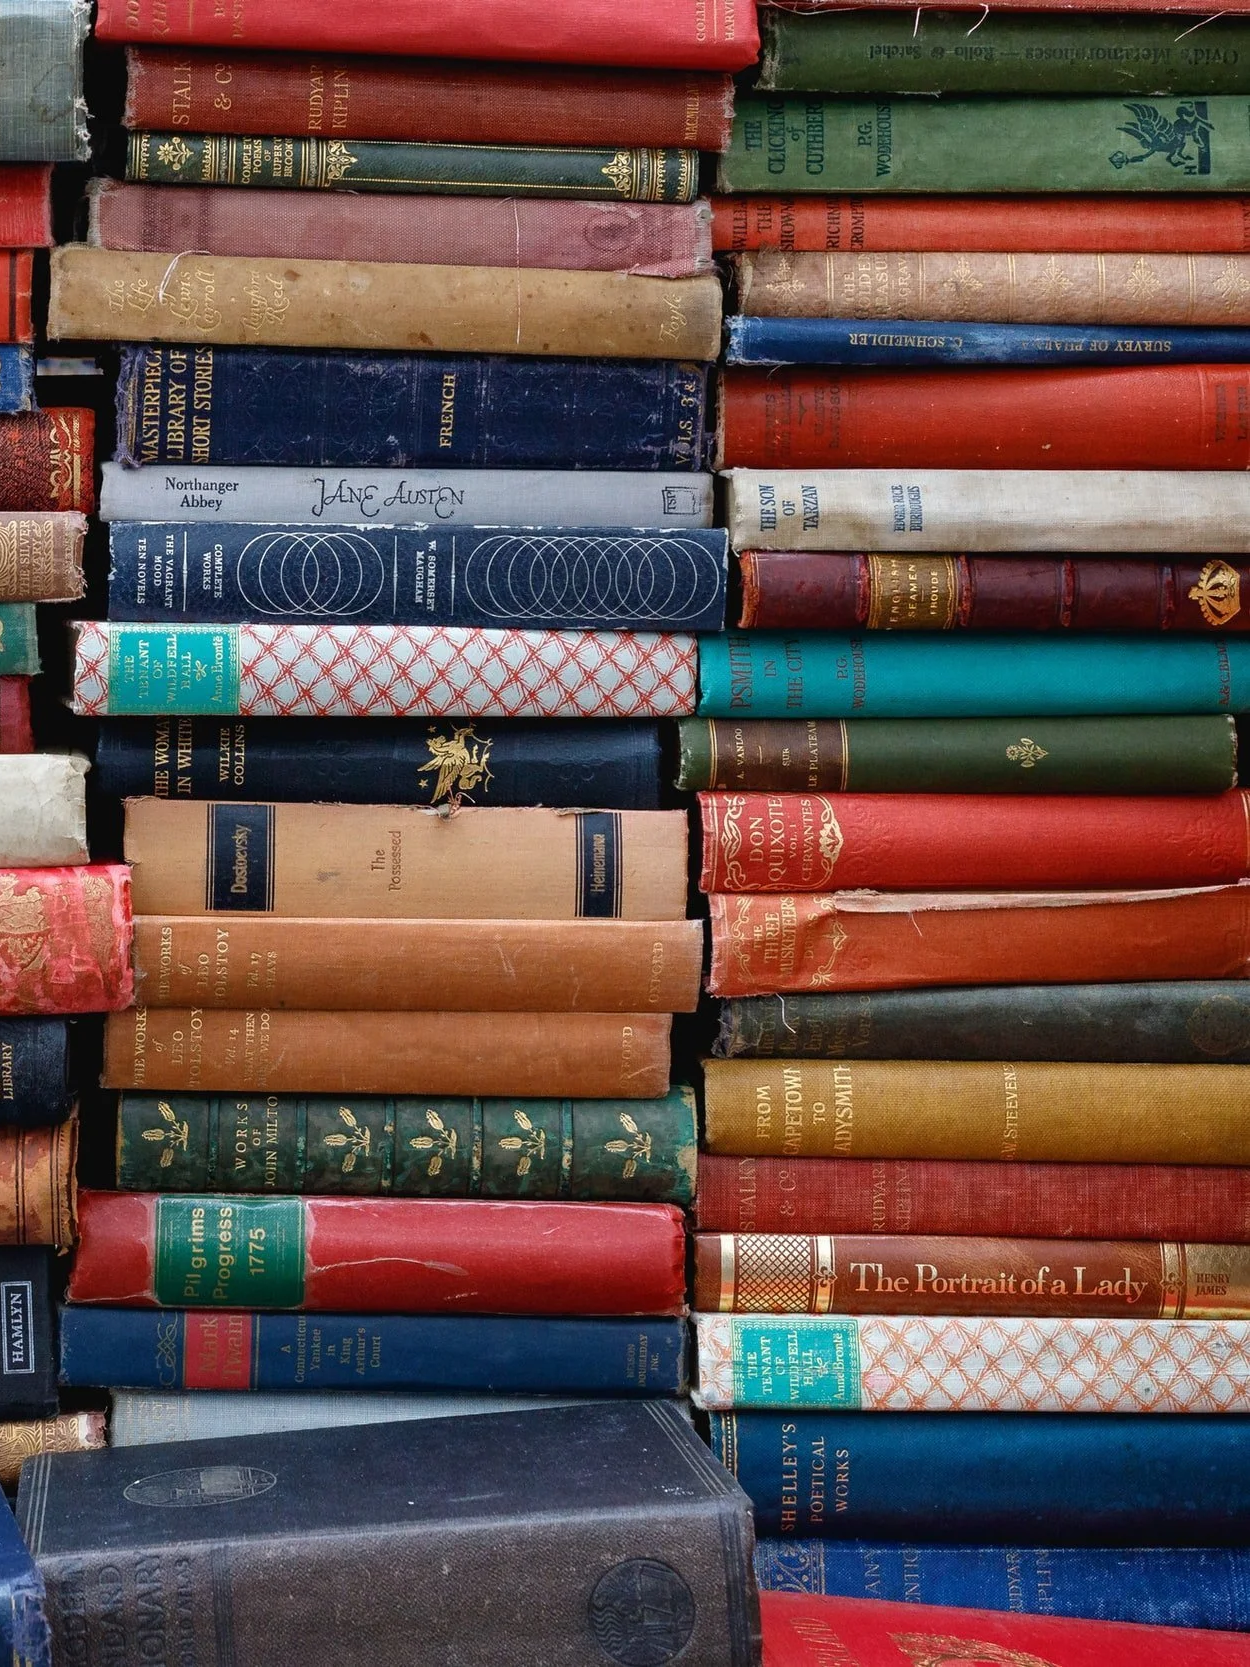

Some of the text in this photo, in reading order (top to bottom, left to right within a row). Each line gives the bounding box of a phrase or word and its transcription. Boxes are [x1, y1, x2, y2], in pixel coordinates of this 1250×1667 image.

[745, 120, 762, 152] THE
[767, 100, 784, 176] CLICKING
[1114, 340, 1172, 353] SURVEY
[167, 349, 187, 461] LIBRARY OF
[192, 346, 213, 463] SHORT STORIES
[439, 373, 456, 448] FRENCH
[165, 478, 239, 494] Northanger
[180, 495, 223, 512] Abbey
[312, 478, 465, 519] JANE AUSTEN
[760, 485, 775, 532] THE SON
[802, 485, 818, 531] TARZAN
[137, 559, 147, 605] NOVELS
[154, 555, 163, 587] MOOD
[165, 554, 175, 609] VAGRANT
[202, 552, 211, 591] WORKS
[214, 543, 223, 599] COMPLETE
[414, 551, 425, 604] MAUGHAM
[427, 555, 438, 611] SOMERSET
[906, 563, 918, 619] SEAMEN
[786, 678, 802, 710] THE
[178, 718, 192, 773] WHITE
[220, 728, 230, 783] WILKIE
[234, 724, 245, 785] COLLINS
[735, 728, 746, 766] VANLOO
[231, 823, 252, 893] Dostoevsky
[371, 849, 386, 873] The
[388, 831, 402, 892] Possessed
[590, 833, 606, 893] Heinemann
[749, 817, 765, 863] DON
[768, 797, 784, 882] QUIXOTE
[801, 799, 813, 882] CERVANTES
[753, 924, 763, 951] THE
[765, 911, 780, 961] THREE
[3, 1042, 14, 1101] LIBRARY
[172, 1031, 183, 1066] LEO
[235, 1102, 249, 1170] WORKS
[756, 1085, 772, 1139] FROM
[813, 1102, 826, 1124] TO
[184, 1207, 206, 1298] Pilgrims
[213, 1206, 234, 1300] Progress
[249, 1226, 266, 1277] 1775
[1196, 1273, 1231, 1284] HENRY
[850, 1263, 1149, 1304] The Portrait of a Lady
[1195, 1285, 1227, 1297] JAMES
[12, 1292, 24, 1364] HAMLYN
[199, 1314, 219, 1375] Mark
[223, 1314, 243, 1379] Twain
[370, 1335, 381, 1368] Court
[747, 1351, 757, 1379] THE
[762, 1336, 773, 1395] TENANT
[789, 1330, 800, 1401] WILDFELL
[804, 1349, 814, 1387] HALL
[781, 1422, 797, 1531] SHELLEY'S
[810, 1435, 825, 1525] POETICAL
[835, 1448, 849, 1514] WORKS
